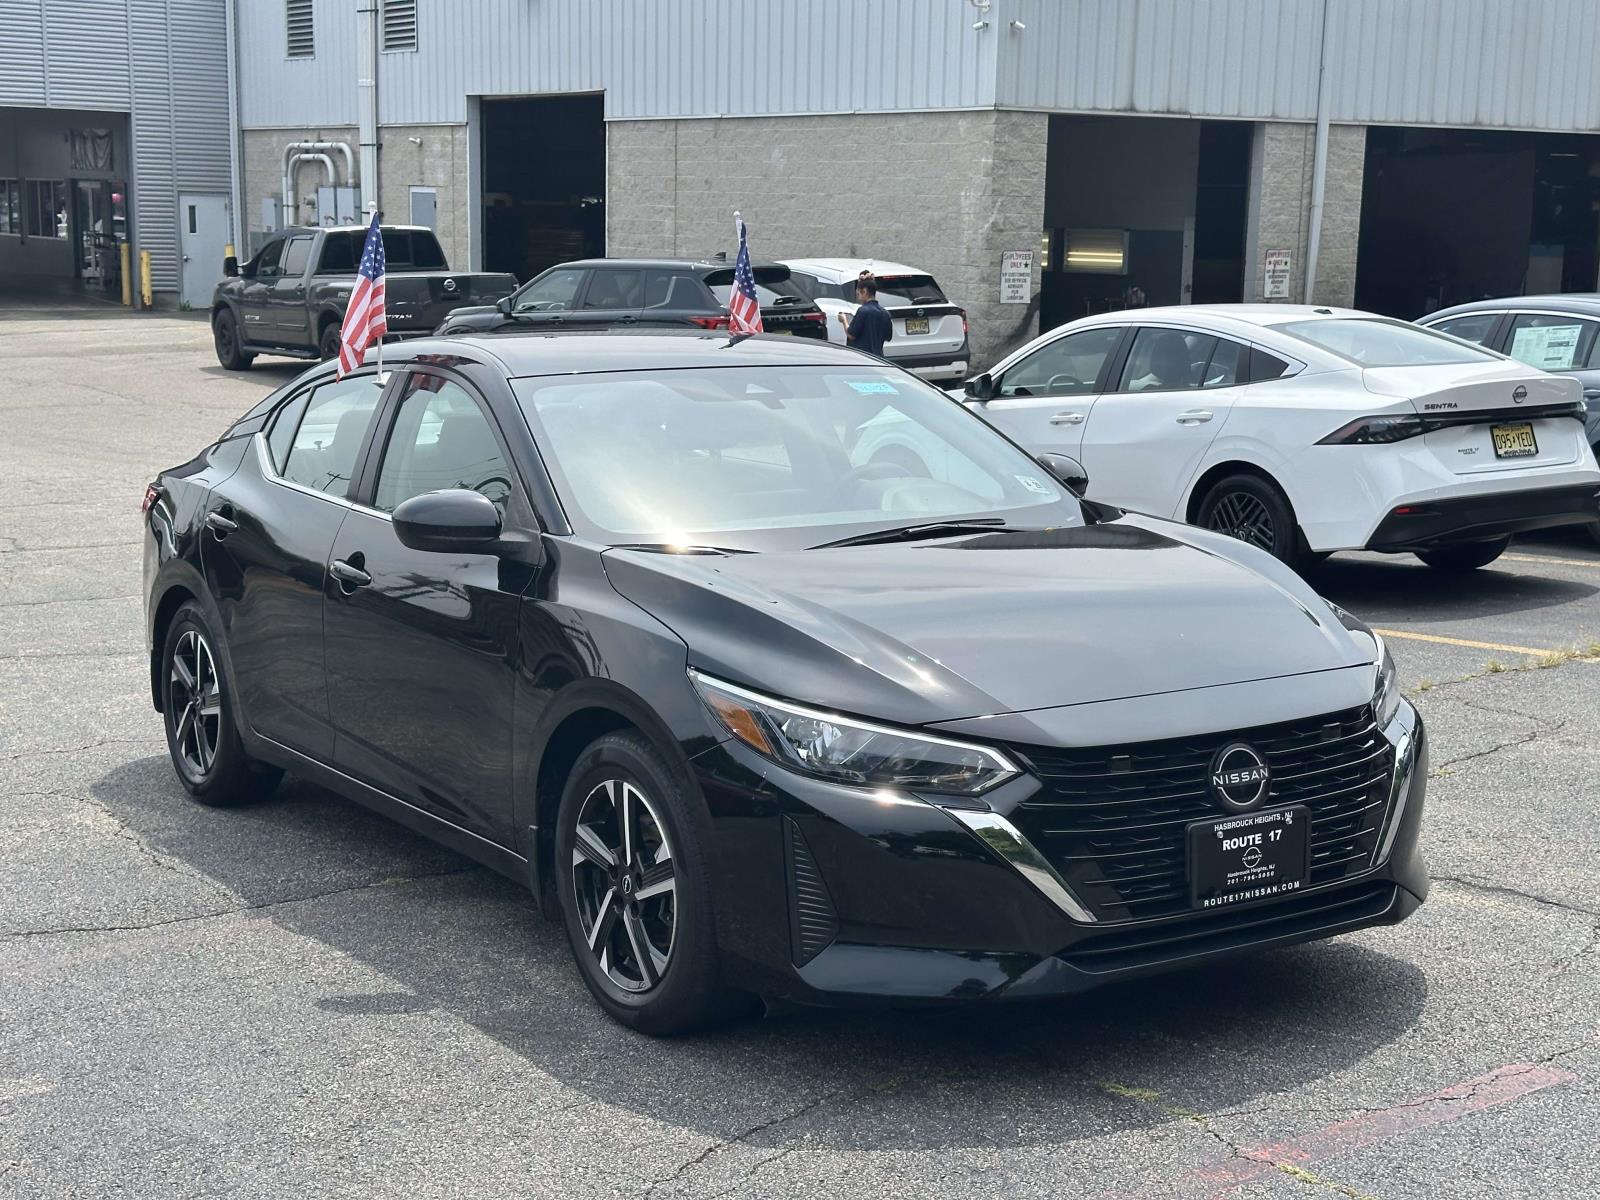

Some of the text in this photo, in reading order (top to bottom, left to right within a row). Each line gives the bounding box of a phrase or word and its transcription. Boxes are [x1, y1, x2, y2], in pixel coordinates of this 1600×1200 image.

[1424, 402, 1458, 410] SENTRA
[1212, 768, 1268, 785] NISSAN
[1214, 818, 1253, 832] HASBROUCK
[1285, 811, 1293, 819] NJ
[1222, 829, 1282, 851] ROUTE 17
[1204, 880, 1300, 907] ROUTE17NISSAN.COM
